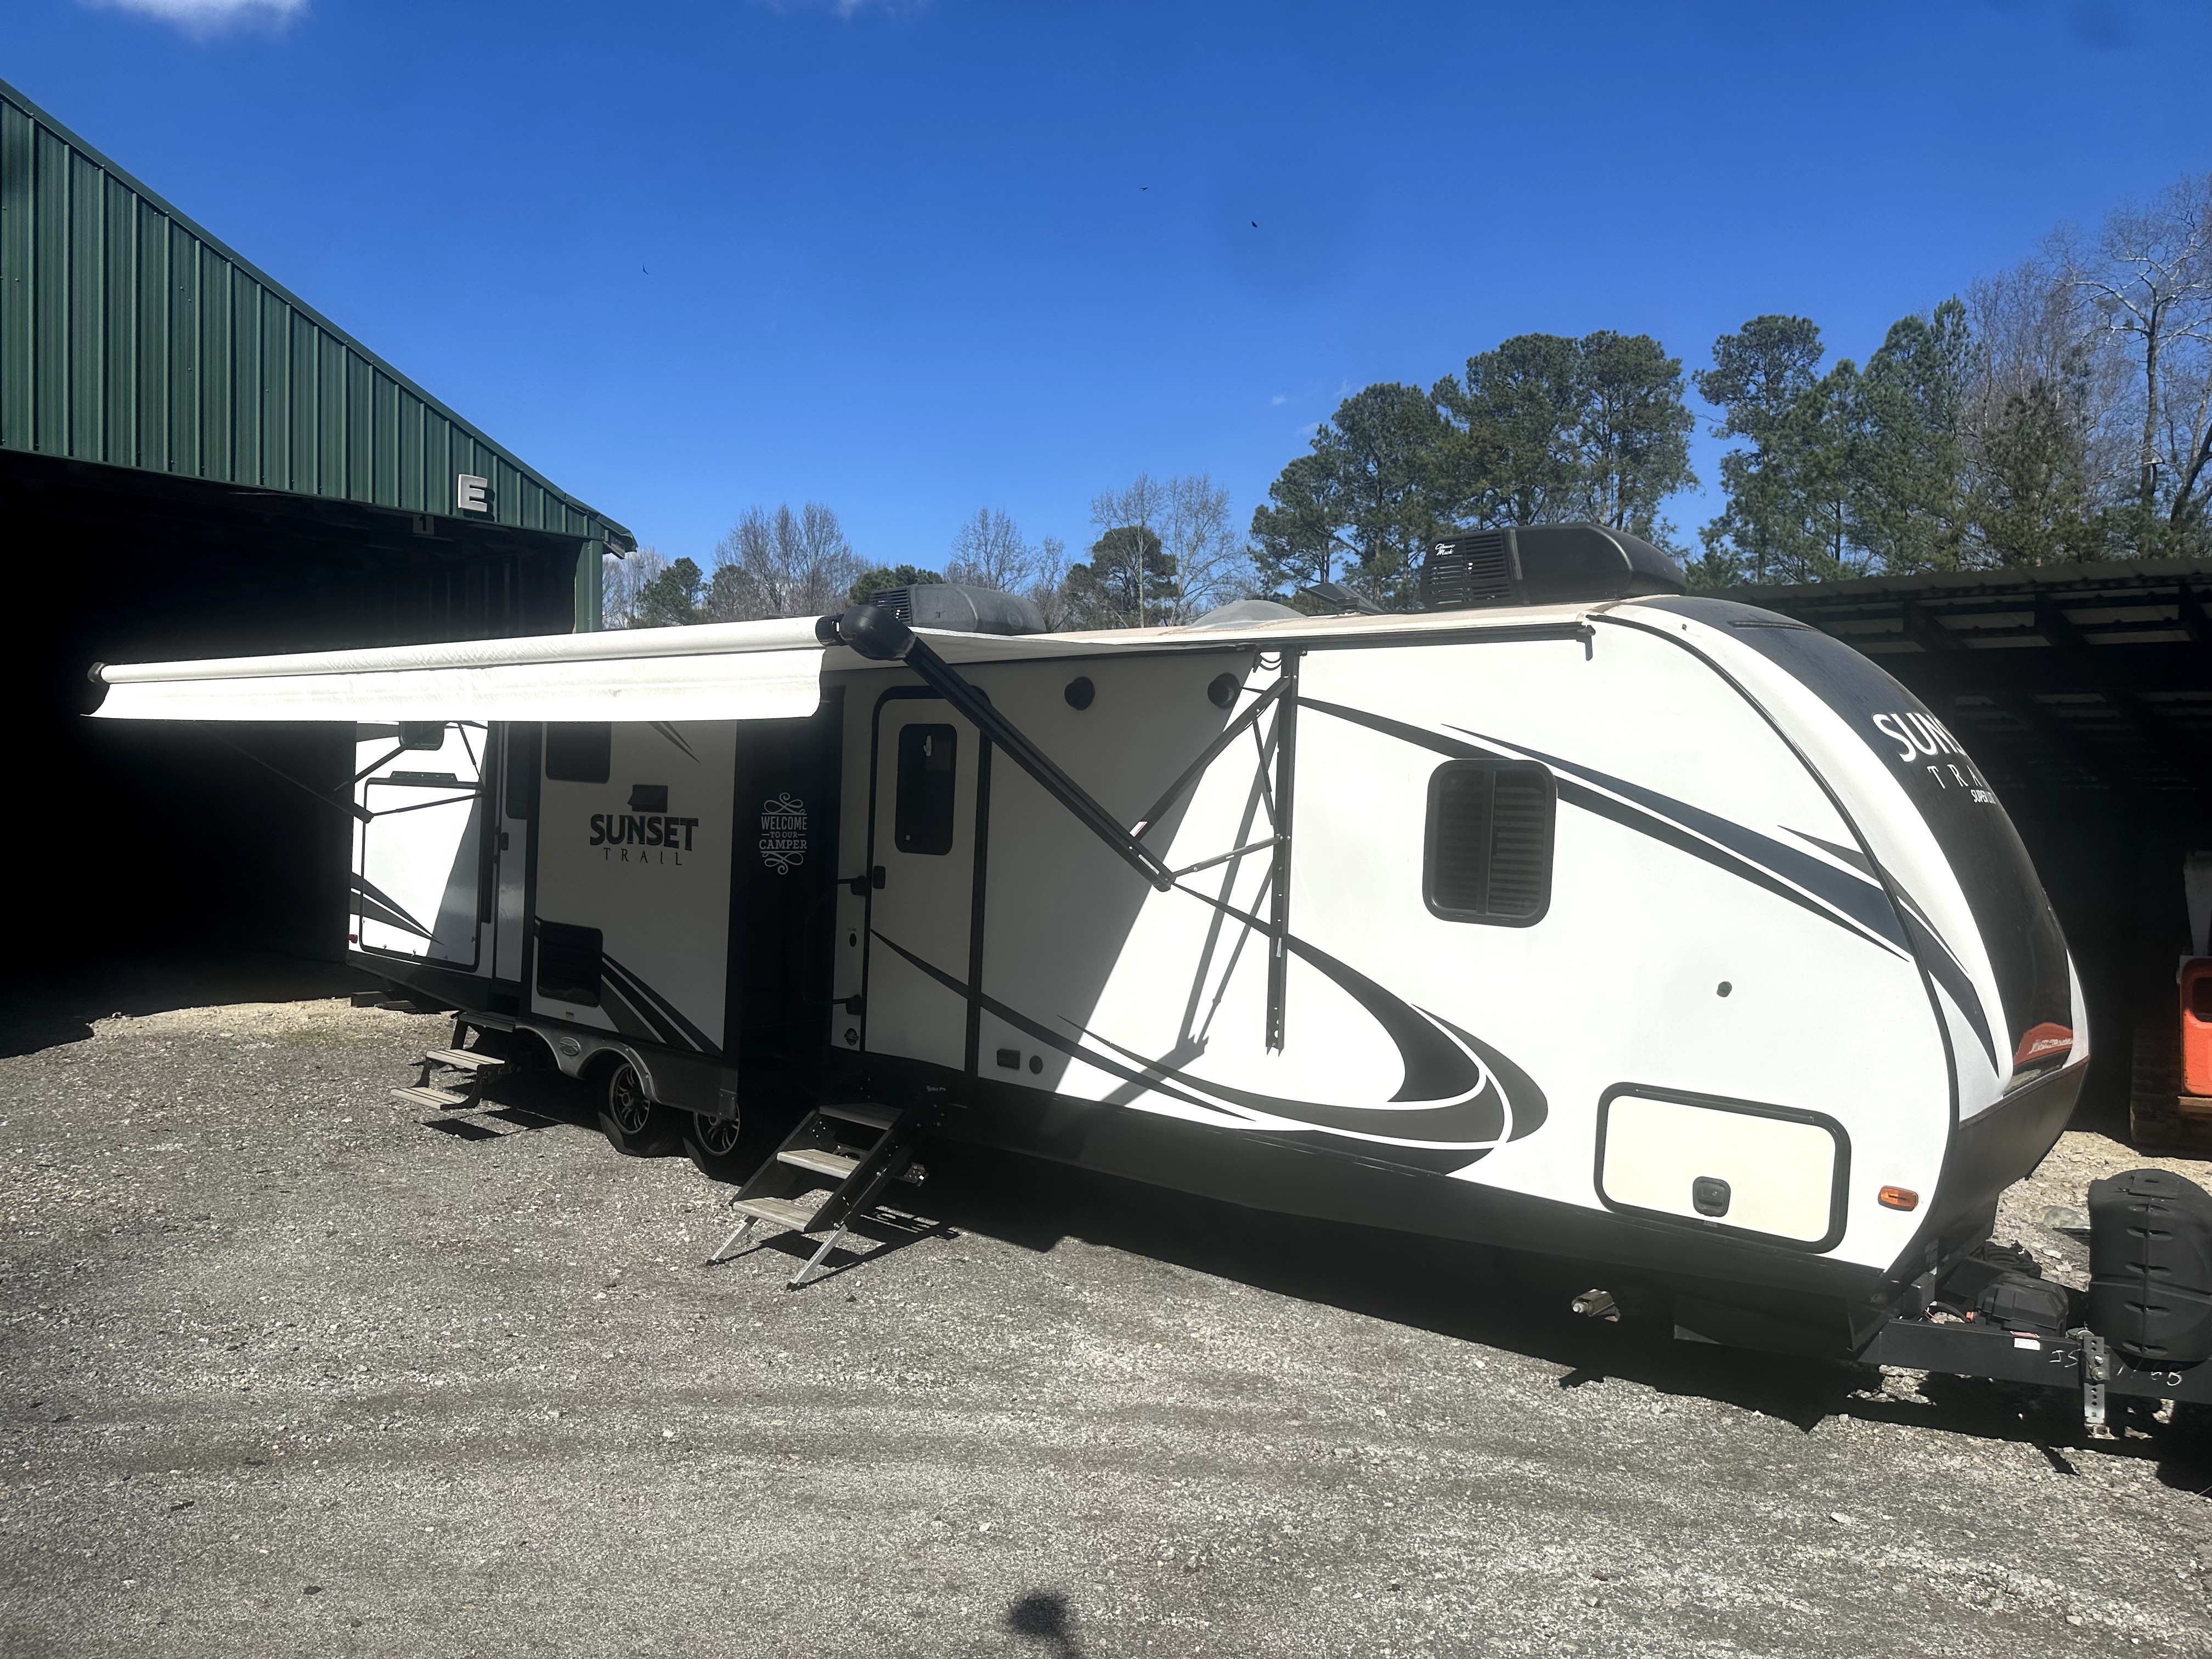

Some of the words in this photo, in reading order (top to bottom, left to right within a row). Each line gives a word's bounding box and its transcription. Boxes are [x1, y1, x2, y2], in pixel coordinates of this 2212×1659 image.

[458, 474, 488, 512] E
[419, 514, 426, 531] 1
[1927, 764, 1983, 789] TRA
[761, 816, 808, 830] WELCOME
[590, 814, 699, 851] SUNSET
[759, 839, 808, 850] CAMPER
[603, 848, 682, 866] TRAIL
